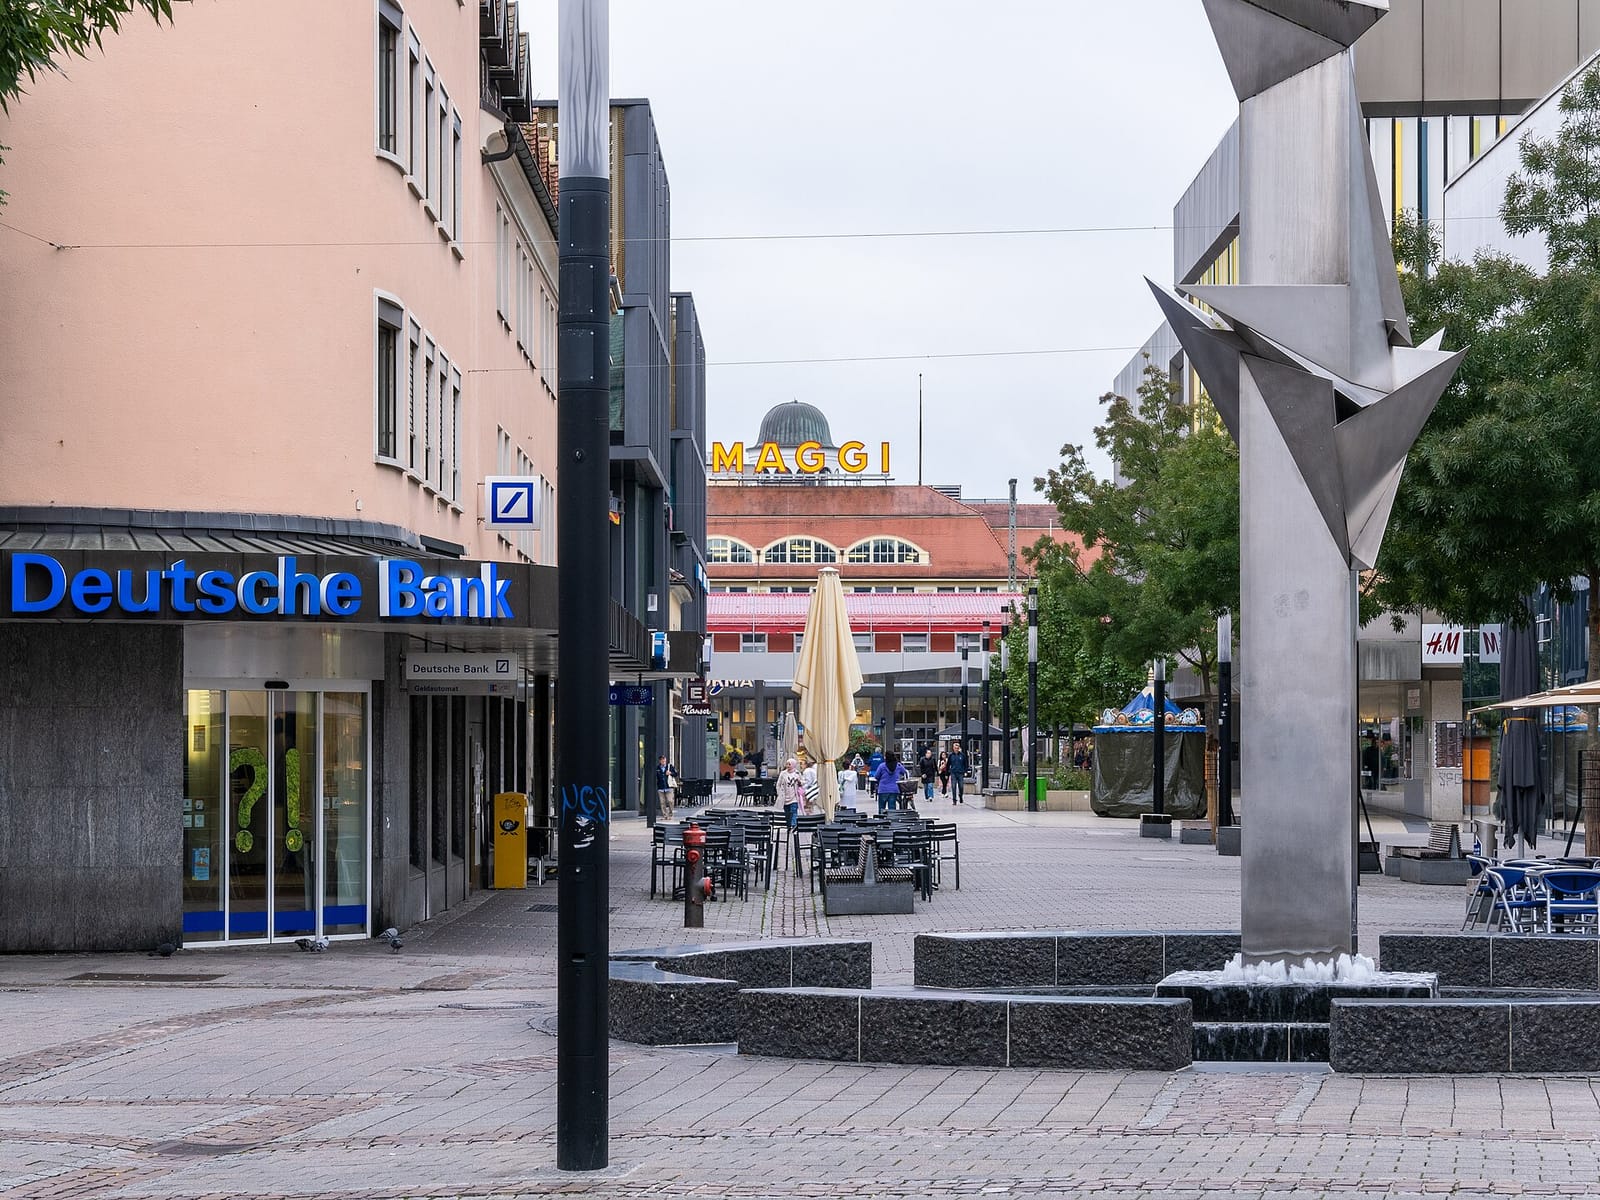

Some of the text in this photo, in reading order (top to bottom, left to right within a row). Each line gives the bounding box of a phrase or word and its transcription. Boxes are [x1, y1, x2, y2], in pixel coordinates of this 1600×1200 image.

[712, 440, 890, 473] MAGGI
[11, 552, 514, 618] Deutsche Bank
[1426, 631, 1460, 655] H&M
[413, 664, 489, 673] Deutsche Bank
